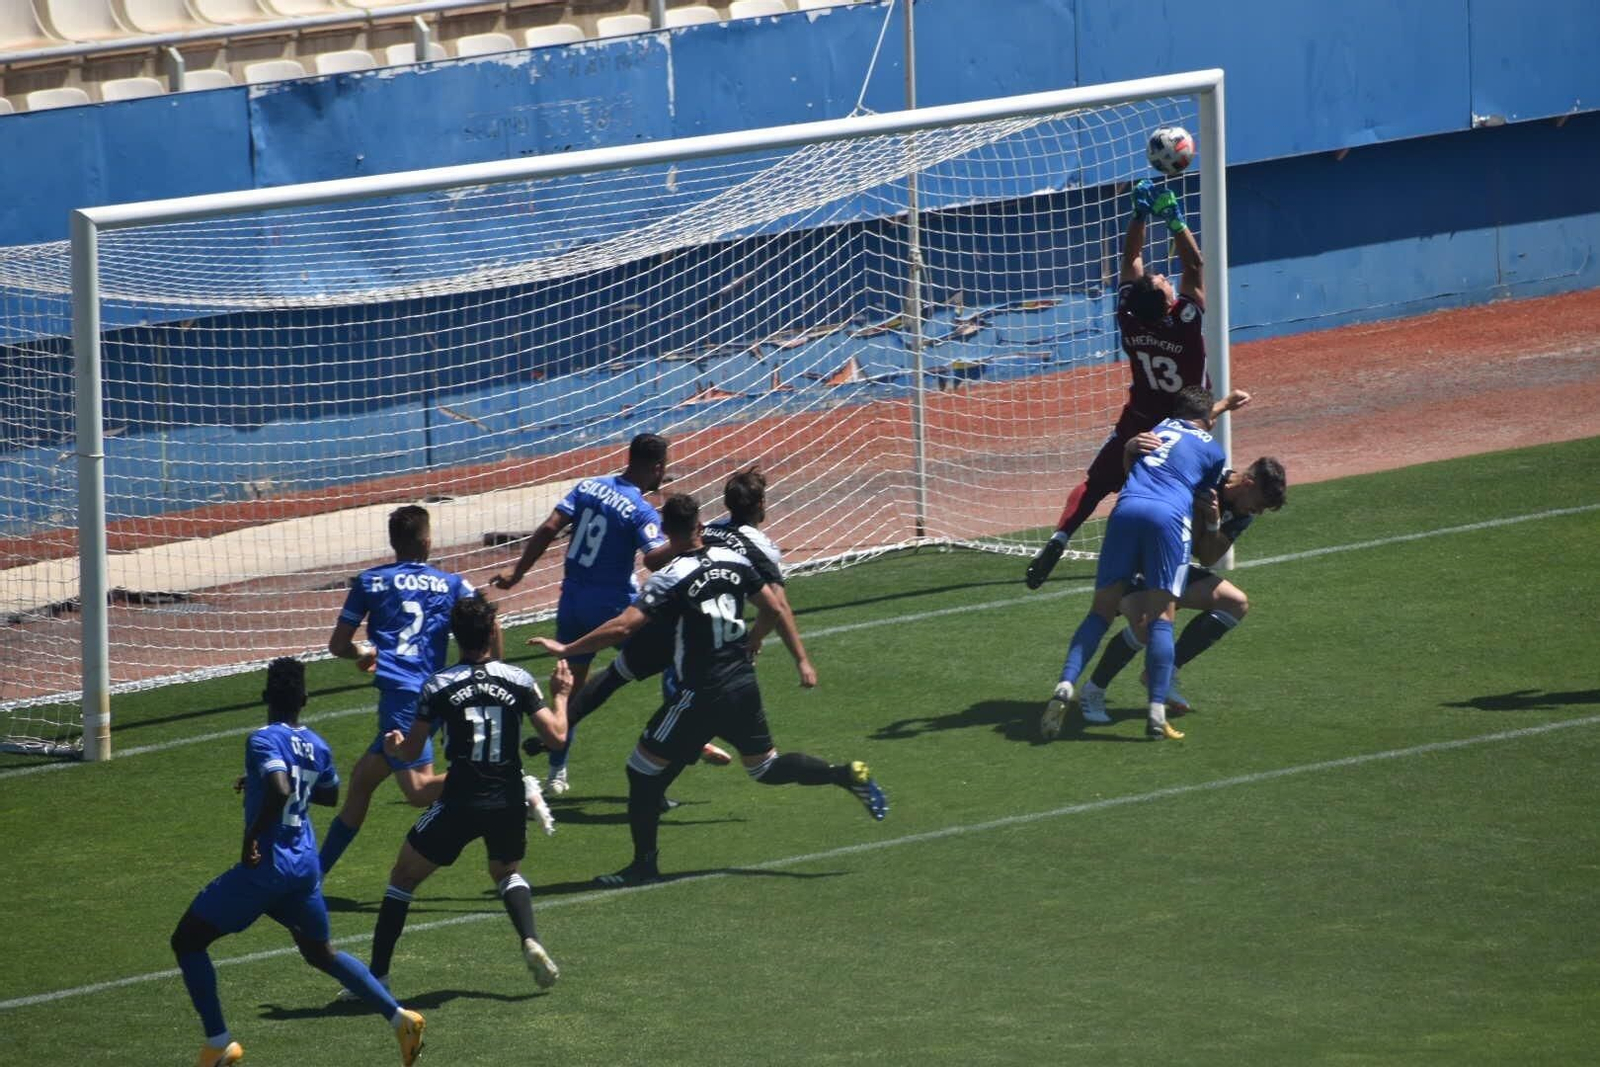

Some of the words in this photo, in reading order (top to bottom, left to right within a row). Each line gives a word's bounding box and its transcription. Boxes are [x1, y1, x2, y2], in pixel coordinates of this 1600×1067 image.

[1137, 351, 1183, 393] 13
[567, 507, 607, 567] 19
[700, 527, 747, 555] USQUETS
[394, 573, 449, 593] COSTA
[687, 568, 742, 597] ELISEO
[396, 601, 424, 656] 2
[449, 683, 516, 706] GRANERO
[464, 706, 503, 762] 11
